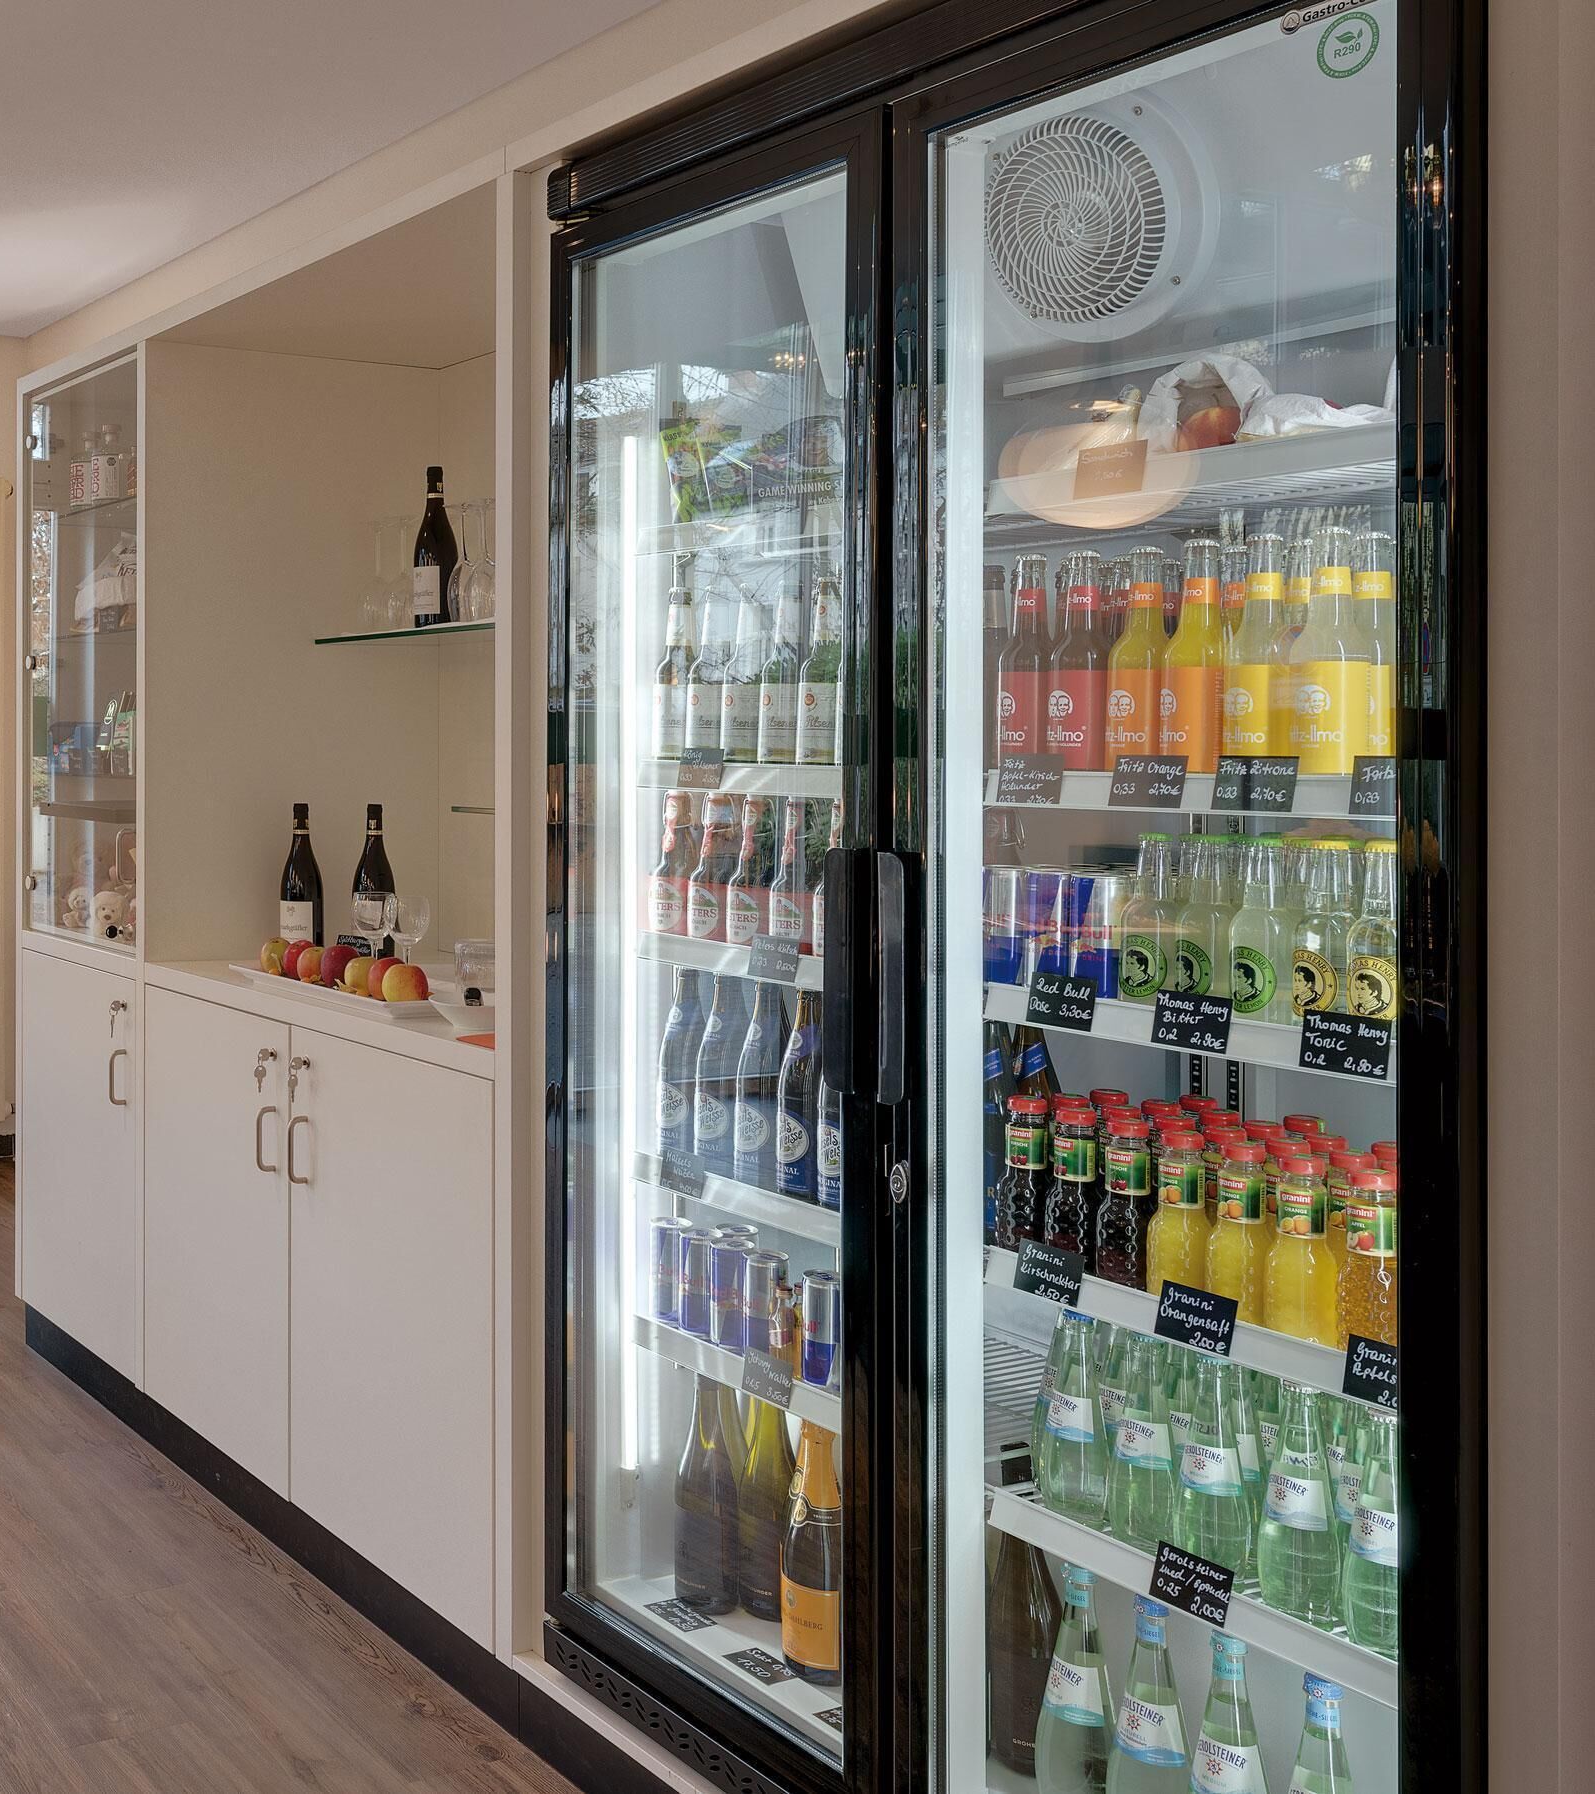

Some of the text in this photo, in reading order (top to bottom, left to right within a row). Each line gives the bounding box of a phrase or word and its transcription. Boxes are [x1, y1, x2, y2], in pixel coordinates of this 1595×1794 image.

[1333, 42, 1362, 59] R290
[758, 486, 786, 498] GAME
[787, 480, 833, 496] WINNING
[1118, 758, 1185, 780] Fritz Orange
[1220, 760, 1296, 776] Fritz Zitrone
[1113, 782, 1181, 797] 0,33 2,70€
[1216, 786, 1287, 802] 0,33 2,70€
[1306, 954, 1329, 974] HENRY
[1063, 982, 1091, 1001] Bull
[1029, 996, 1093, 1020] Dose 3,30€
[1157, 992, 1229, 1022] Thomas Henry
[1163, 1010, 1204, 1024] Bitter
[1158, 1028, 1225, 1050] 0,2 2,90€
[1306, 1015, 1389, 1046] Thomas Henry
[1305, 1032, 1348, 1051] Tonic
[1304, 1052, 1385, 1076] 0,2 2,90€
[1281, 1193, 1312, 1206] granini
[1284, 1206, 1308, 1215] ORANGE
[1346, 1205, 1376, 1218] granini
[1020, 1262, 1082, 1292] Kirschnektar
[1035, 1284, 1071, 1306] 2,50€
[1160, 1304, 1230, 1339] Orangensaft
[1188, 1331, 1227, 1354] 2,00€
[1157, 1577, 1225, 1622] 0,25 2,00€
